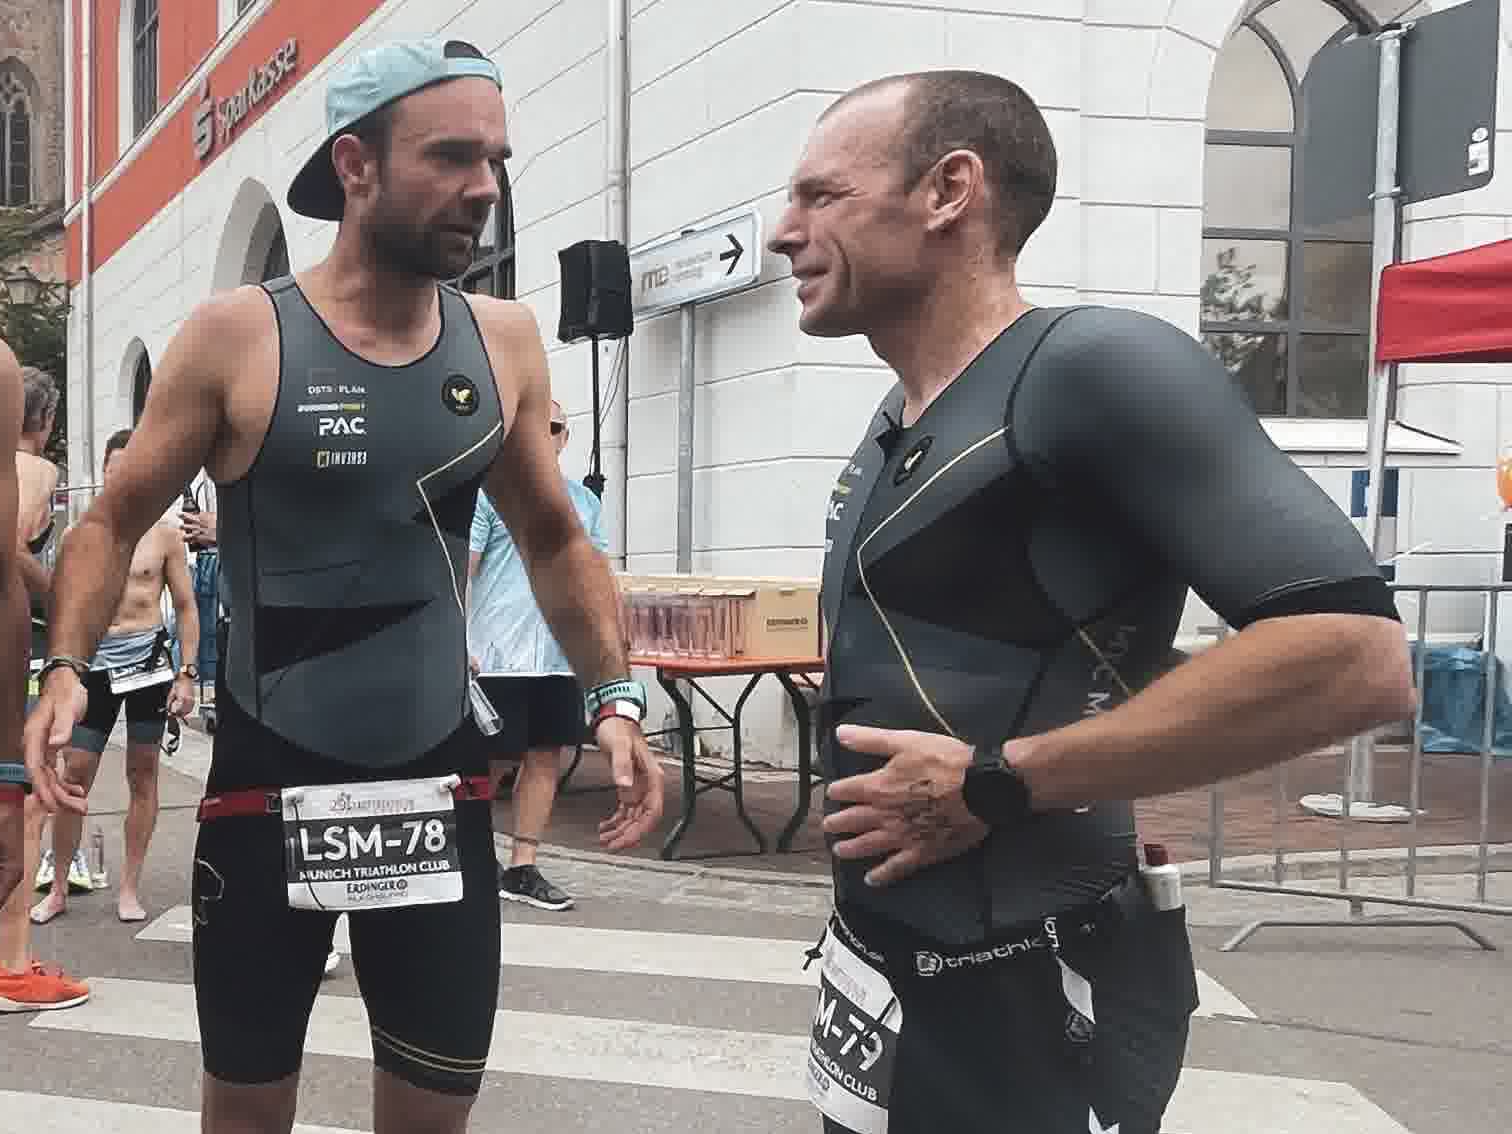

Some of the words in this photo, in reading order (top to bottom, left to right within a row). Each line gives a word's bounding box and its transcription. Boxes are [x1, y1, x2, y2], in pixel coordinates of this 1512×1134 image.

[320, 417, 365, 435] PAC
[300, 819, 447, 861] LSM-78
[300, 868, 351, 880] MUNICH
[354, 863, 417, 879] TRIATHLON
[419, 860, 450, 872] CLUB
[843, 1074, 878, 1101] CLUB
